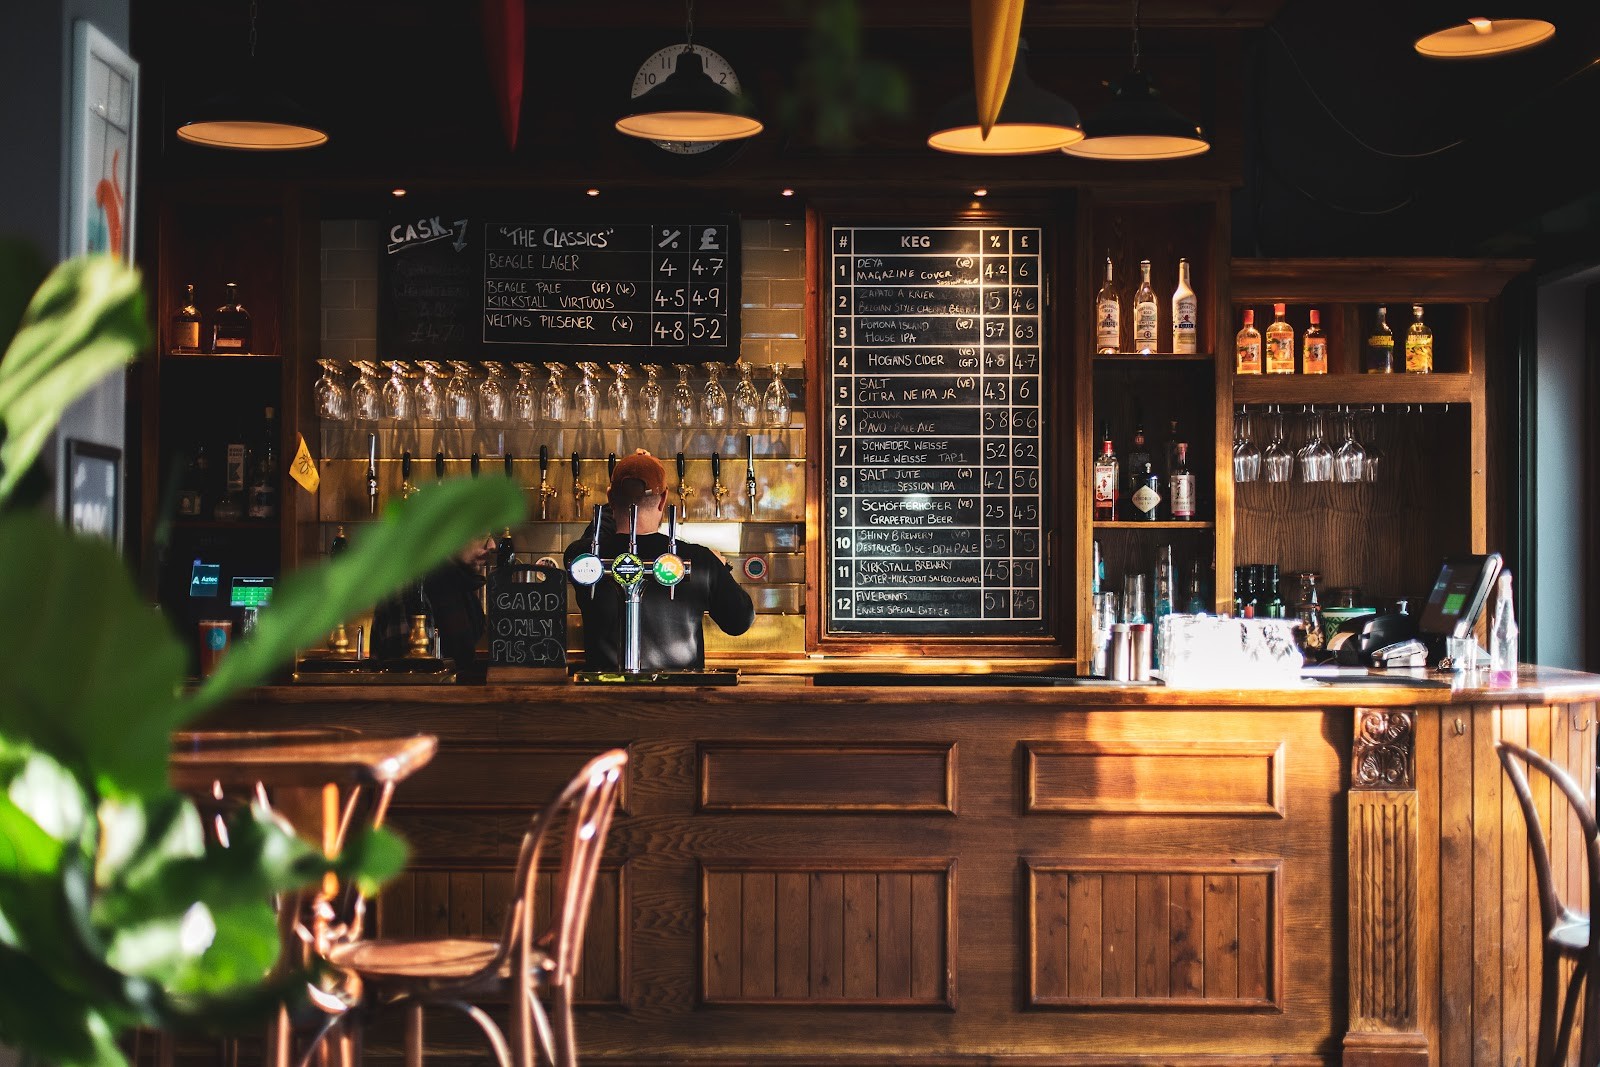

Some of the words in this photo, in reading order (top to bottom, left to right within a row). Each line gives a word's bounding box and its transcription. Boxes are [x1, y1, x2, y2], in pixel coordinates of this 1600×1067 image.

[661, 57, 671, 69] 11
[643, 72, 656, 85] 10
[719, 72, 727, 85] 2
[390, 216, 448, 243] CASK
[658, 229, 682, 249] %
[698, 228, 720, 250] £
[839, 236, 848, 248] #
[901, 236, 931, 248] KEG
[990, 235, 1001, 248] %
[1020, 236, 1029, 248] £
[488, 253, 534, 269] BEAGLE
[541, 254, 580, 272] LAGER
[659, 258, 678, 276] 4
[857, 258, 883, 268] DEYA
[839, 264, 846, 277] 1
[856, 269, 915, 282] MAGAZINE
[920, 270, 953, 280] COVER
[1019, 262, 1029, 277] 6
[487, 280, 528, 294] BEAGLE
[536, 282, 561, 294] PALE
[897, 288, 904, 298] A
[487, 295, 548, 308] KIRKSTALL
[559, 296, 615, 310] VIRTUOUS
[839, 296, 847, 308] 2
[989, 290, 1001, 311] 5
[894, 302, 915, 314] STYLE
[486, 314, 532, 328] VELTINS
[540, 315, 595, 331] PILSENER
[860, 318, 896, 330] POMONA
[898, 320, 930, 331] ISLAND
[839, 326, 847, 339] 3
[865, 331, 896, 343] HOUSE
[900, 332, 917, 343] IPA
[838, 356, 848, 368] 4
[868, 353, 912, 367] HOGANS
[914, 354, 945, 366] CIDER
[859, 377, 891, 390] SALT
[1019, 380, 1030, 398] 6
[839, 386, 848, 398] 5
[858, 390, 896, 402] CITRA
[921, 388, 938, 400] IPA
[941, 387, 957, 400] JR
[839, 414, 848, 427] 6
[859, 420, 887, 433] PAVO
[917, 422, 935, 433] ALE
[838, 445, 848, 458] 7
[861, 440, 911, 451] SCHNEIDER
[914, 440, 949, 451] WEISSE
[863, 453, 890, 463] HELLE
[892, 453, 928, 464] WEISSE
[839, 475, 848, 488] 8
[859, 468, 888, 482] SALT
[894, 469, 921, 480] JUTE
[897, 481, 935, 492] SESSION
[939, 481, 956, 491] IPA
[839, 506, 848, 519] 9
[869, 513, 924, 525] GRAPEFRUIT
[927, 513, 953, 524] BEER
[860, 530, 890, 541] SHINY
[891, 529, 934, 541] BREWERY
[836, 536, 850, 549] 10
[855, 543, 901, 553] DESTRUCTO
[904, 544, 925, 554] DISC
[932, 544, 953, 554] DDH
[954, 543, 979, 554] PALE
[1023, 532, 1035, 552] 5
[838, 565, 849, 578] 11
[859, 559, 914, 573] KIRKSTALL
[914, 559, 953, 571] BREWERY
[909, 574, 928, 583] STOUT
[928, 574, 953, 583] SALTED
[952, 574, 982, 584] CARAMEL
[497, 590, 560, 612] CARD
[855, 591, 876, 601] FIVE
[878, 591, 908, 601] POINTS
[837, 598, 850, 610] 12
[856, 606, 885, 615] ERNEST
[886, 605, 916, 615] SPECIAL
[497, 617, 553, 637] ONLY
[492, 638, 527, 664] PLS
